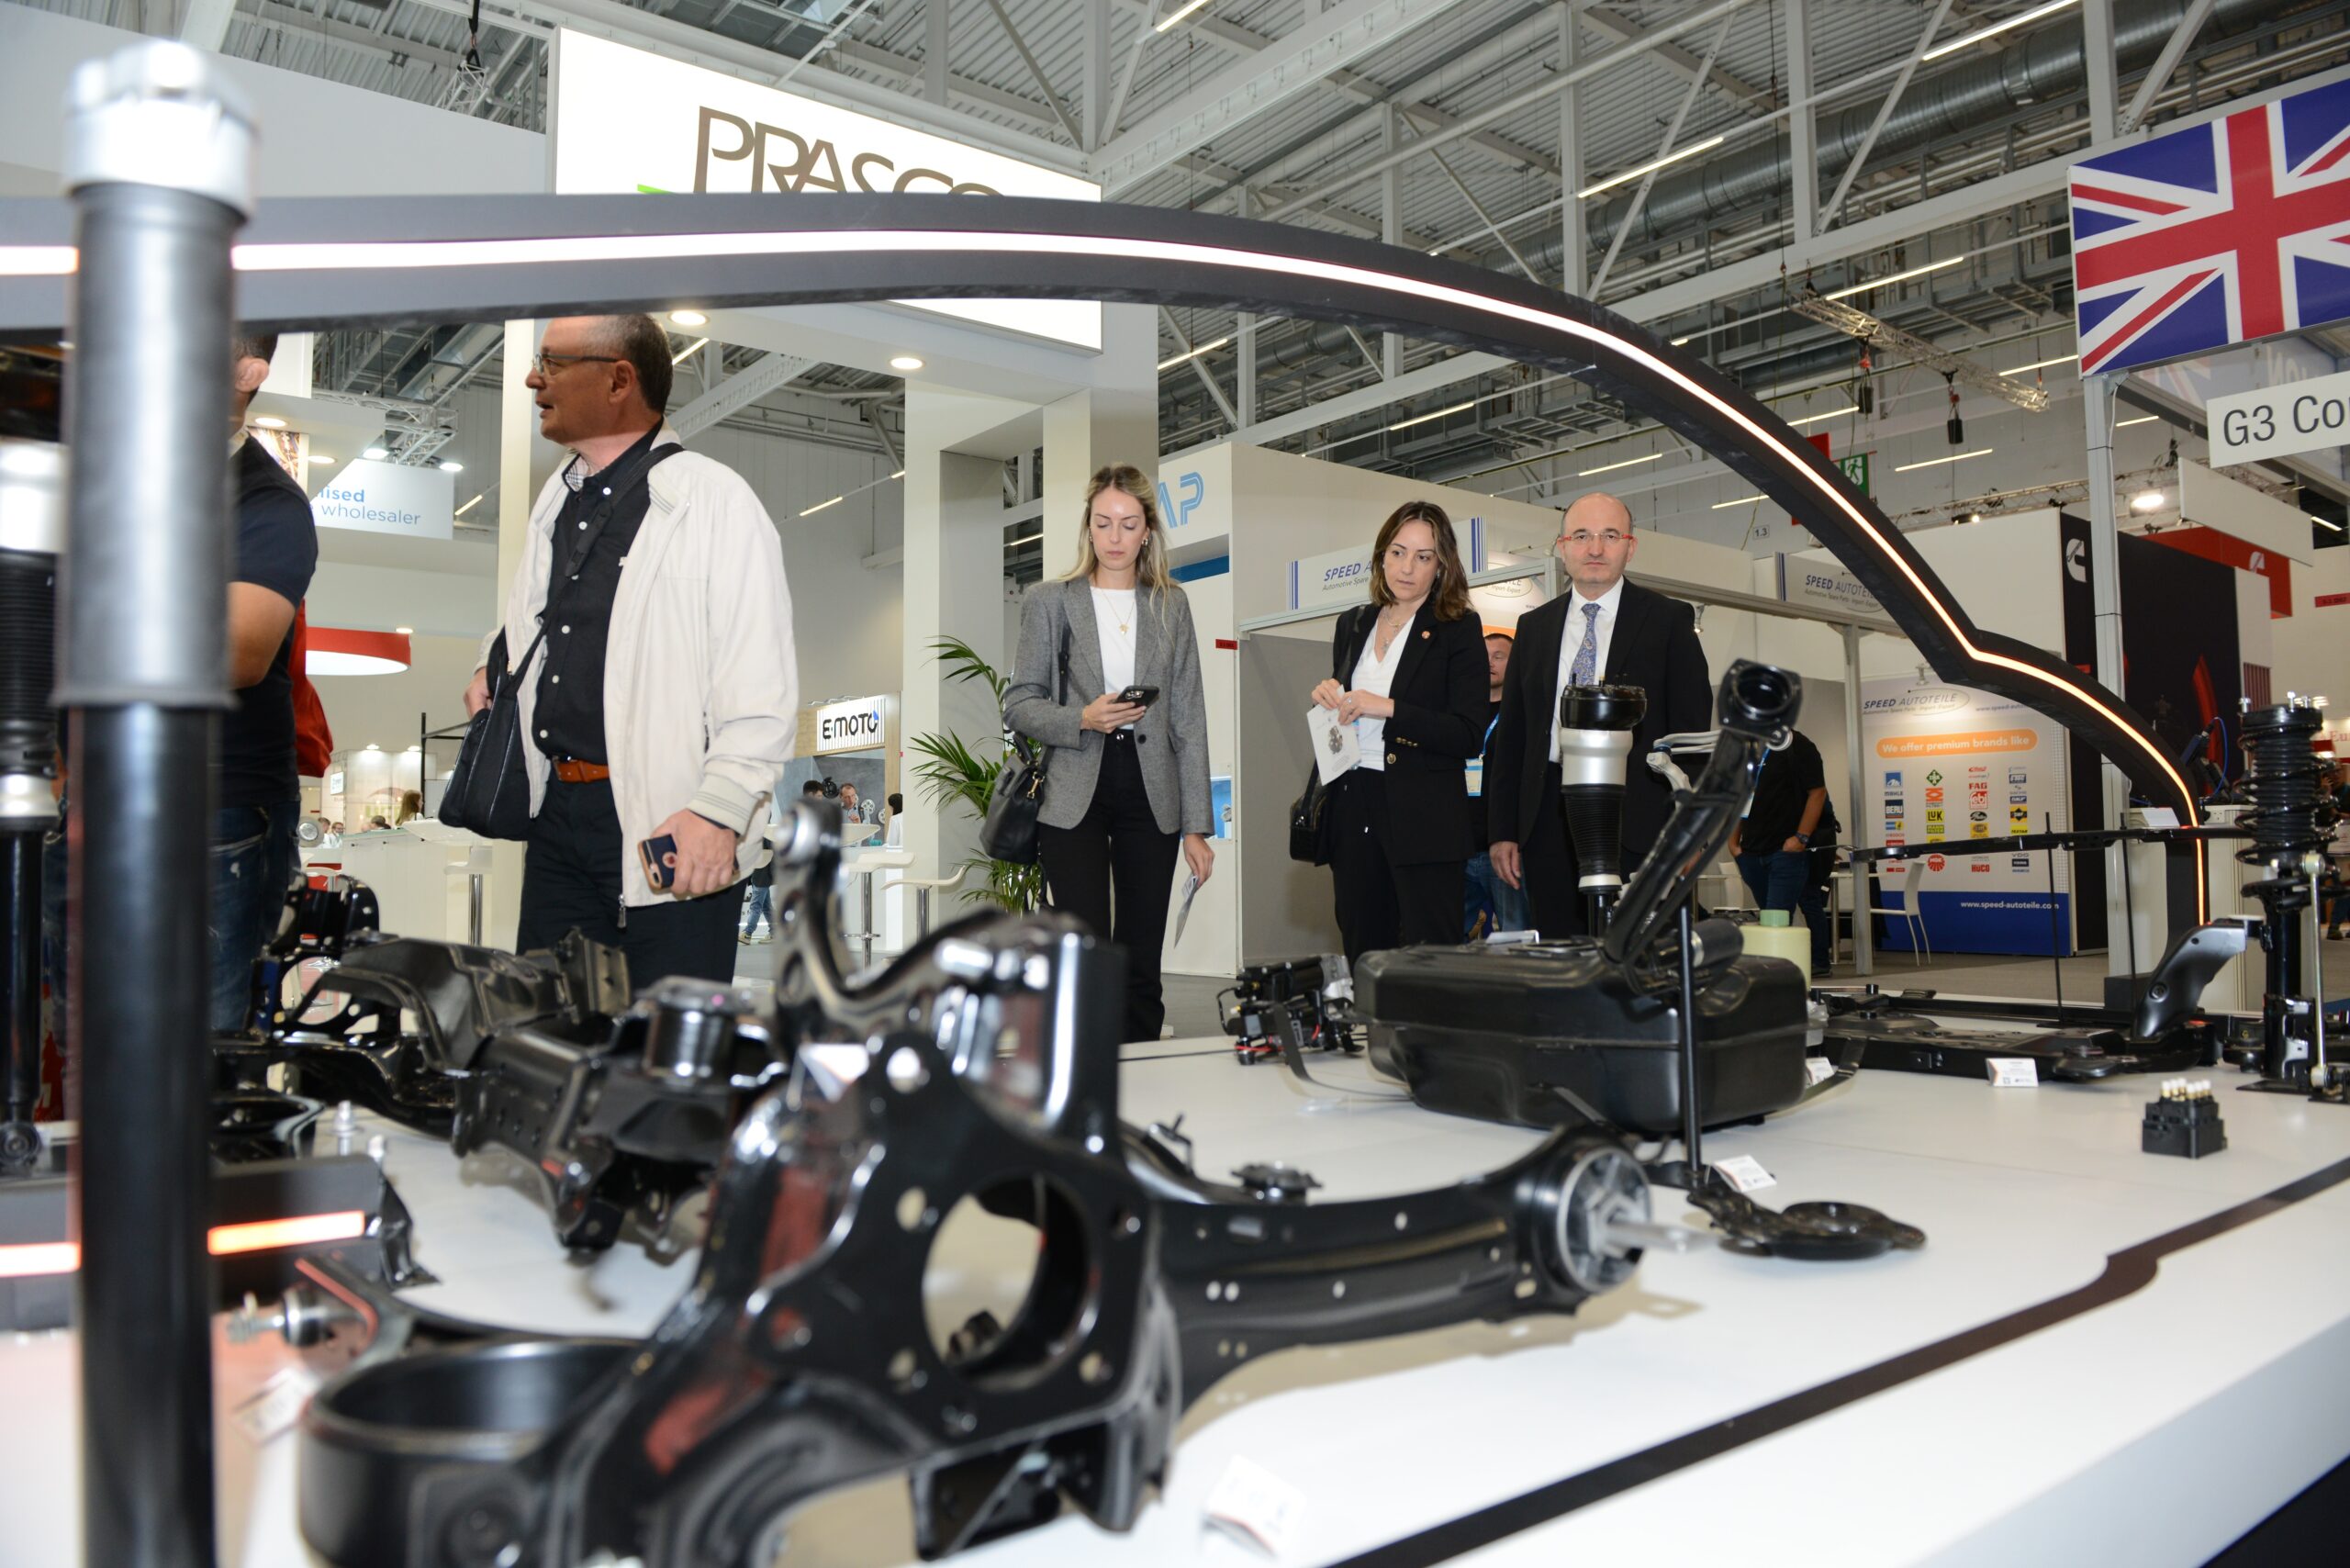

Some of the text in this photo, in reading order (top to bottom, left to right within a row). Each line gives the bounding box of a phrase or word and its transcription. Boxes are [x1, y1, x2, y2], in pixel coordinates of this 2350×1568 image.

[693, 106, 1005, 196] PRAS
[2223, 395, 2350, 447] G3 Co
[321, 503, 421, 525] wholesaler
[1754, 528, 1768, 537] 1.3
[1324, 563, 1361, 582] SPEED
[1322, 577, 1369, 592] Automotive Spare
[1806, 575, 1834, 590] SPEED
[1863, 693, 1958, 710] SPEED AUTOTEILE
[1883, 735, 2031, 754] We offer premium brands like
[1969, 782, 1987, 790] FAG
[1961, 901, 2060, 910] www.speed-autoteile.com
